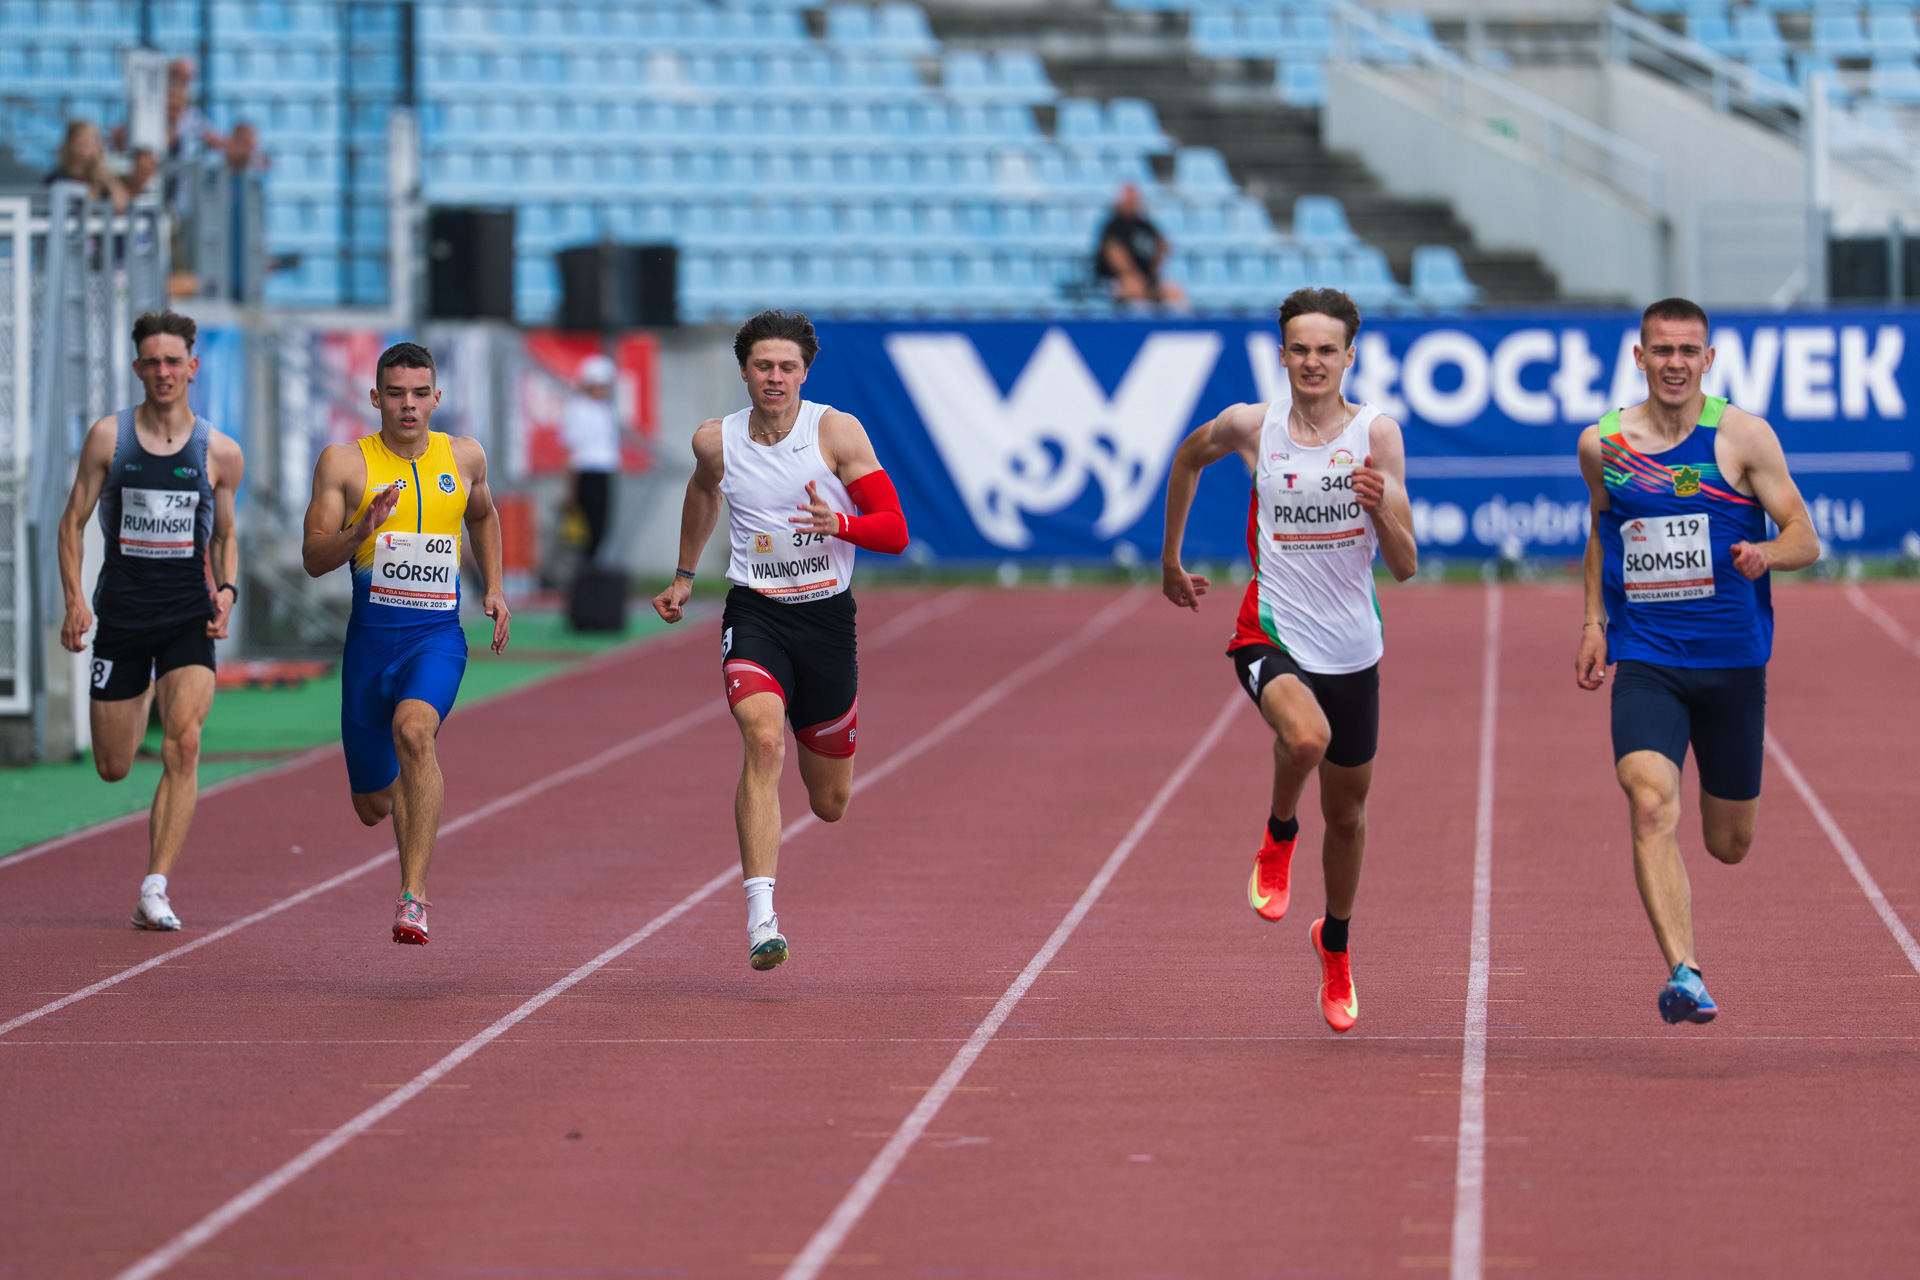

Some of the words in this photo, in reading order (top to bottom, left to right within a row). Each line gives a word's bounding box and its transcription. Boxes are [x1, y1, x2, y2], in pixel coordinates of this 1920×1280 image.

[1321, 475, 1353, 492] 340
[165, 494, 192, 508] 751
[1274, 502, 1360, 524] PRACHNIO
[124, 514, 191, 534] RUMIŃSKI
[1665, 519, 1700, 538] 119
[426, 538, 452, 554] 602
[1280, 543, 1335, 551] WŁOCŁAWEK
[1337, 539, 1356, 548] 2025
[752, 555, 830, 580] WALINOWSKI
[1626, 550, 1706, 572] SŁOMSKI
[382, 560, 449, 583] GÓRSKI
[379, 596, 429, 608] WŁOCŁAWEK
[772, 594, 810, 602] OCŁAWEK
[812, 590, 830, 599] 2025
[92, 660, 105, 684] 8
